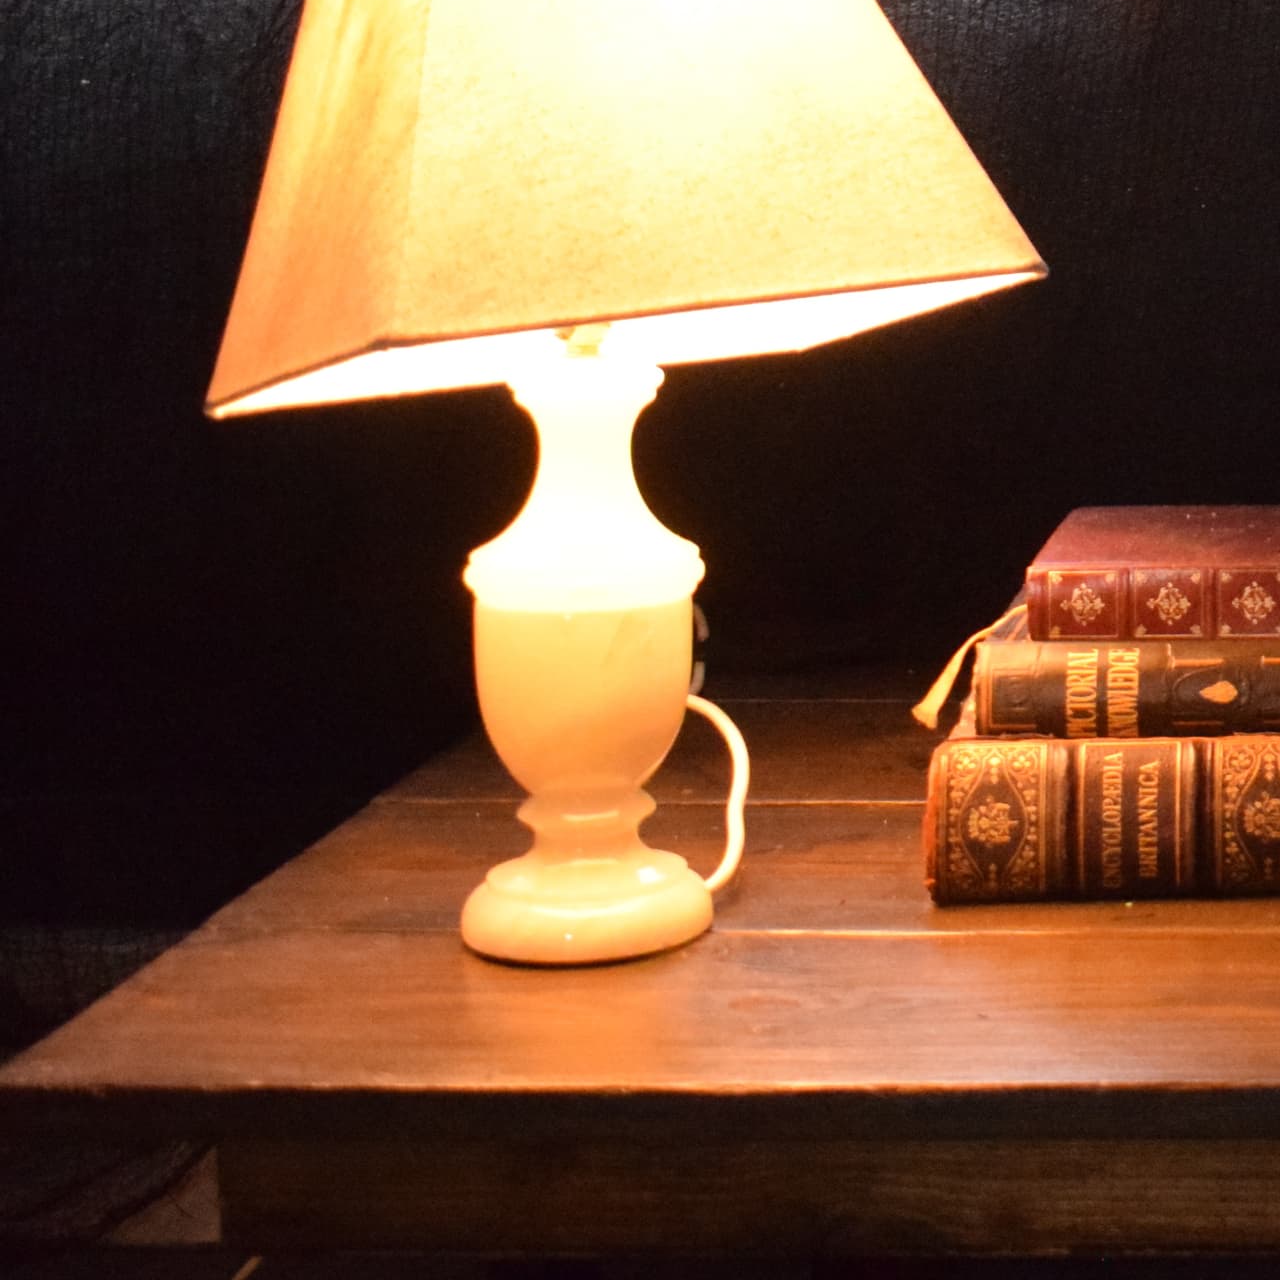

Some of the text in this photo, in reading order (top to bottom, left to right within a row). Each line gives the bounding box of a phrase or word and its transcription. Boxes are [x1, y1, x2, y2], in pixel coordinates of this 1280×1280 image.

[1065, 647, 1099, 738] PICTORIAL
[1106, 646, 1140, 738] KNOWLEDGE
[1101, 751, 1123, 889] ENCYCLOPÆDIA
[1135, 759, 1160, 880] BRITANNICA
